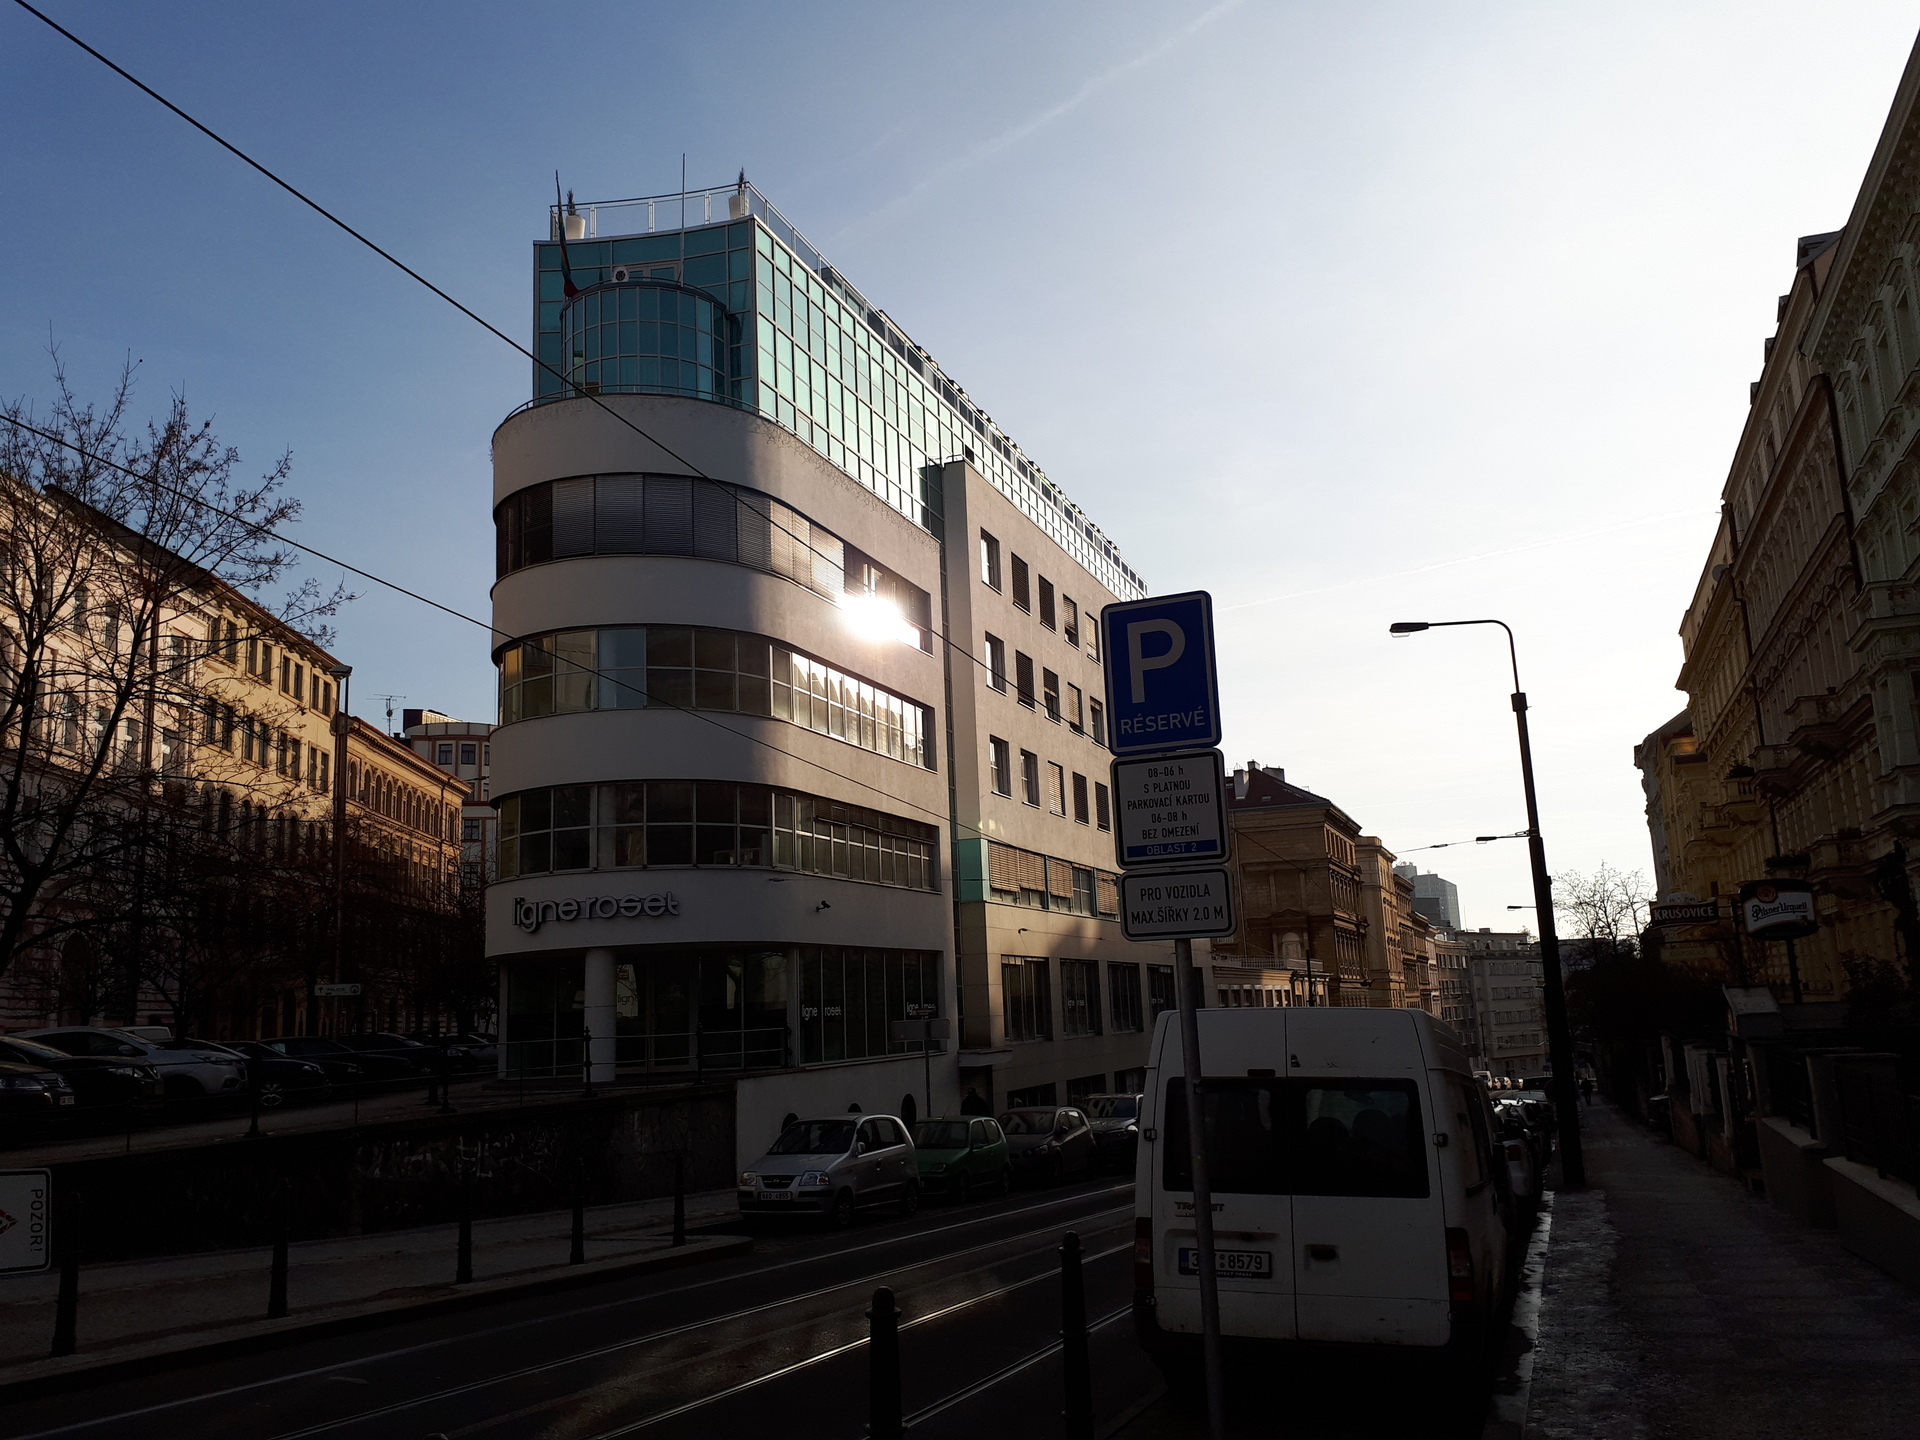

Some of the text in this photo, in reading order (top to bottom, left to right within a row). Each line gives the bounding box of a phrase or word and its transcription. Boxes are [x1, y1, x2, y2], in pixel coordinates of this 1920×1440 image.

[1127, 618, 1186, 704] P
[1120, 705, 1206, 735] RÉSERVÉ
[1147, 765, 1184, 778] 08-06 h
[1143, 779, 1191, 794] S PLATNOU
[1127, 793, 1210, 811] PARKOVACÍ KARTOU
[1151, 811, 1187, 823] 06-08 h
[1142, 822, 1200, 840] BEZ OMEZENÍ
[1146, 842, 1197, 855] OBLAST 2
[1140, 883, 1211, 901] PRO VOZIDLA
[512, 891, 680, 933] ligne roset
[1131, 905, 1224, 925] MAX.ŠÍŘKY 2,0 M
[1653, 906, 1715, 921] KRUŠOVICE
[1751, 901, 1808, 922] Pilsner Urquell
[801, 1004, 842, 1021] ligne roset
[30, 1188, 44, 1252] POZOR!
[1227, 1254, 1263, 1271] 8579
